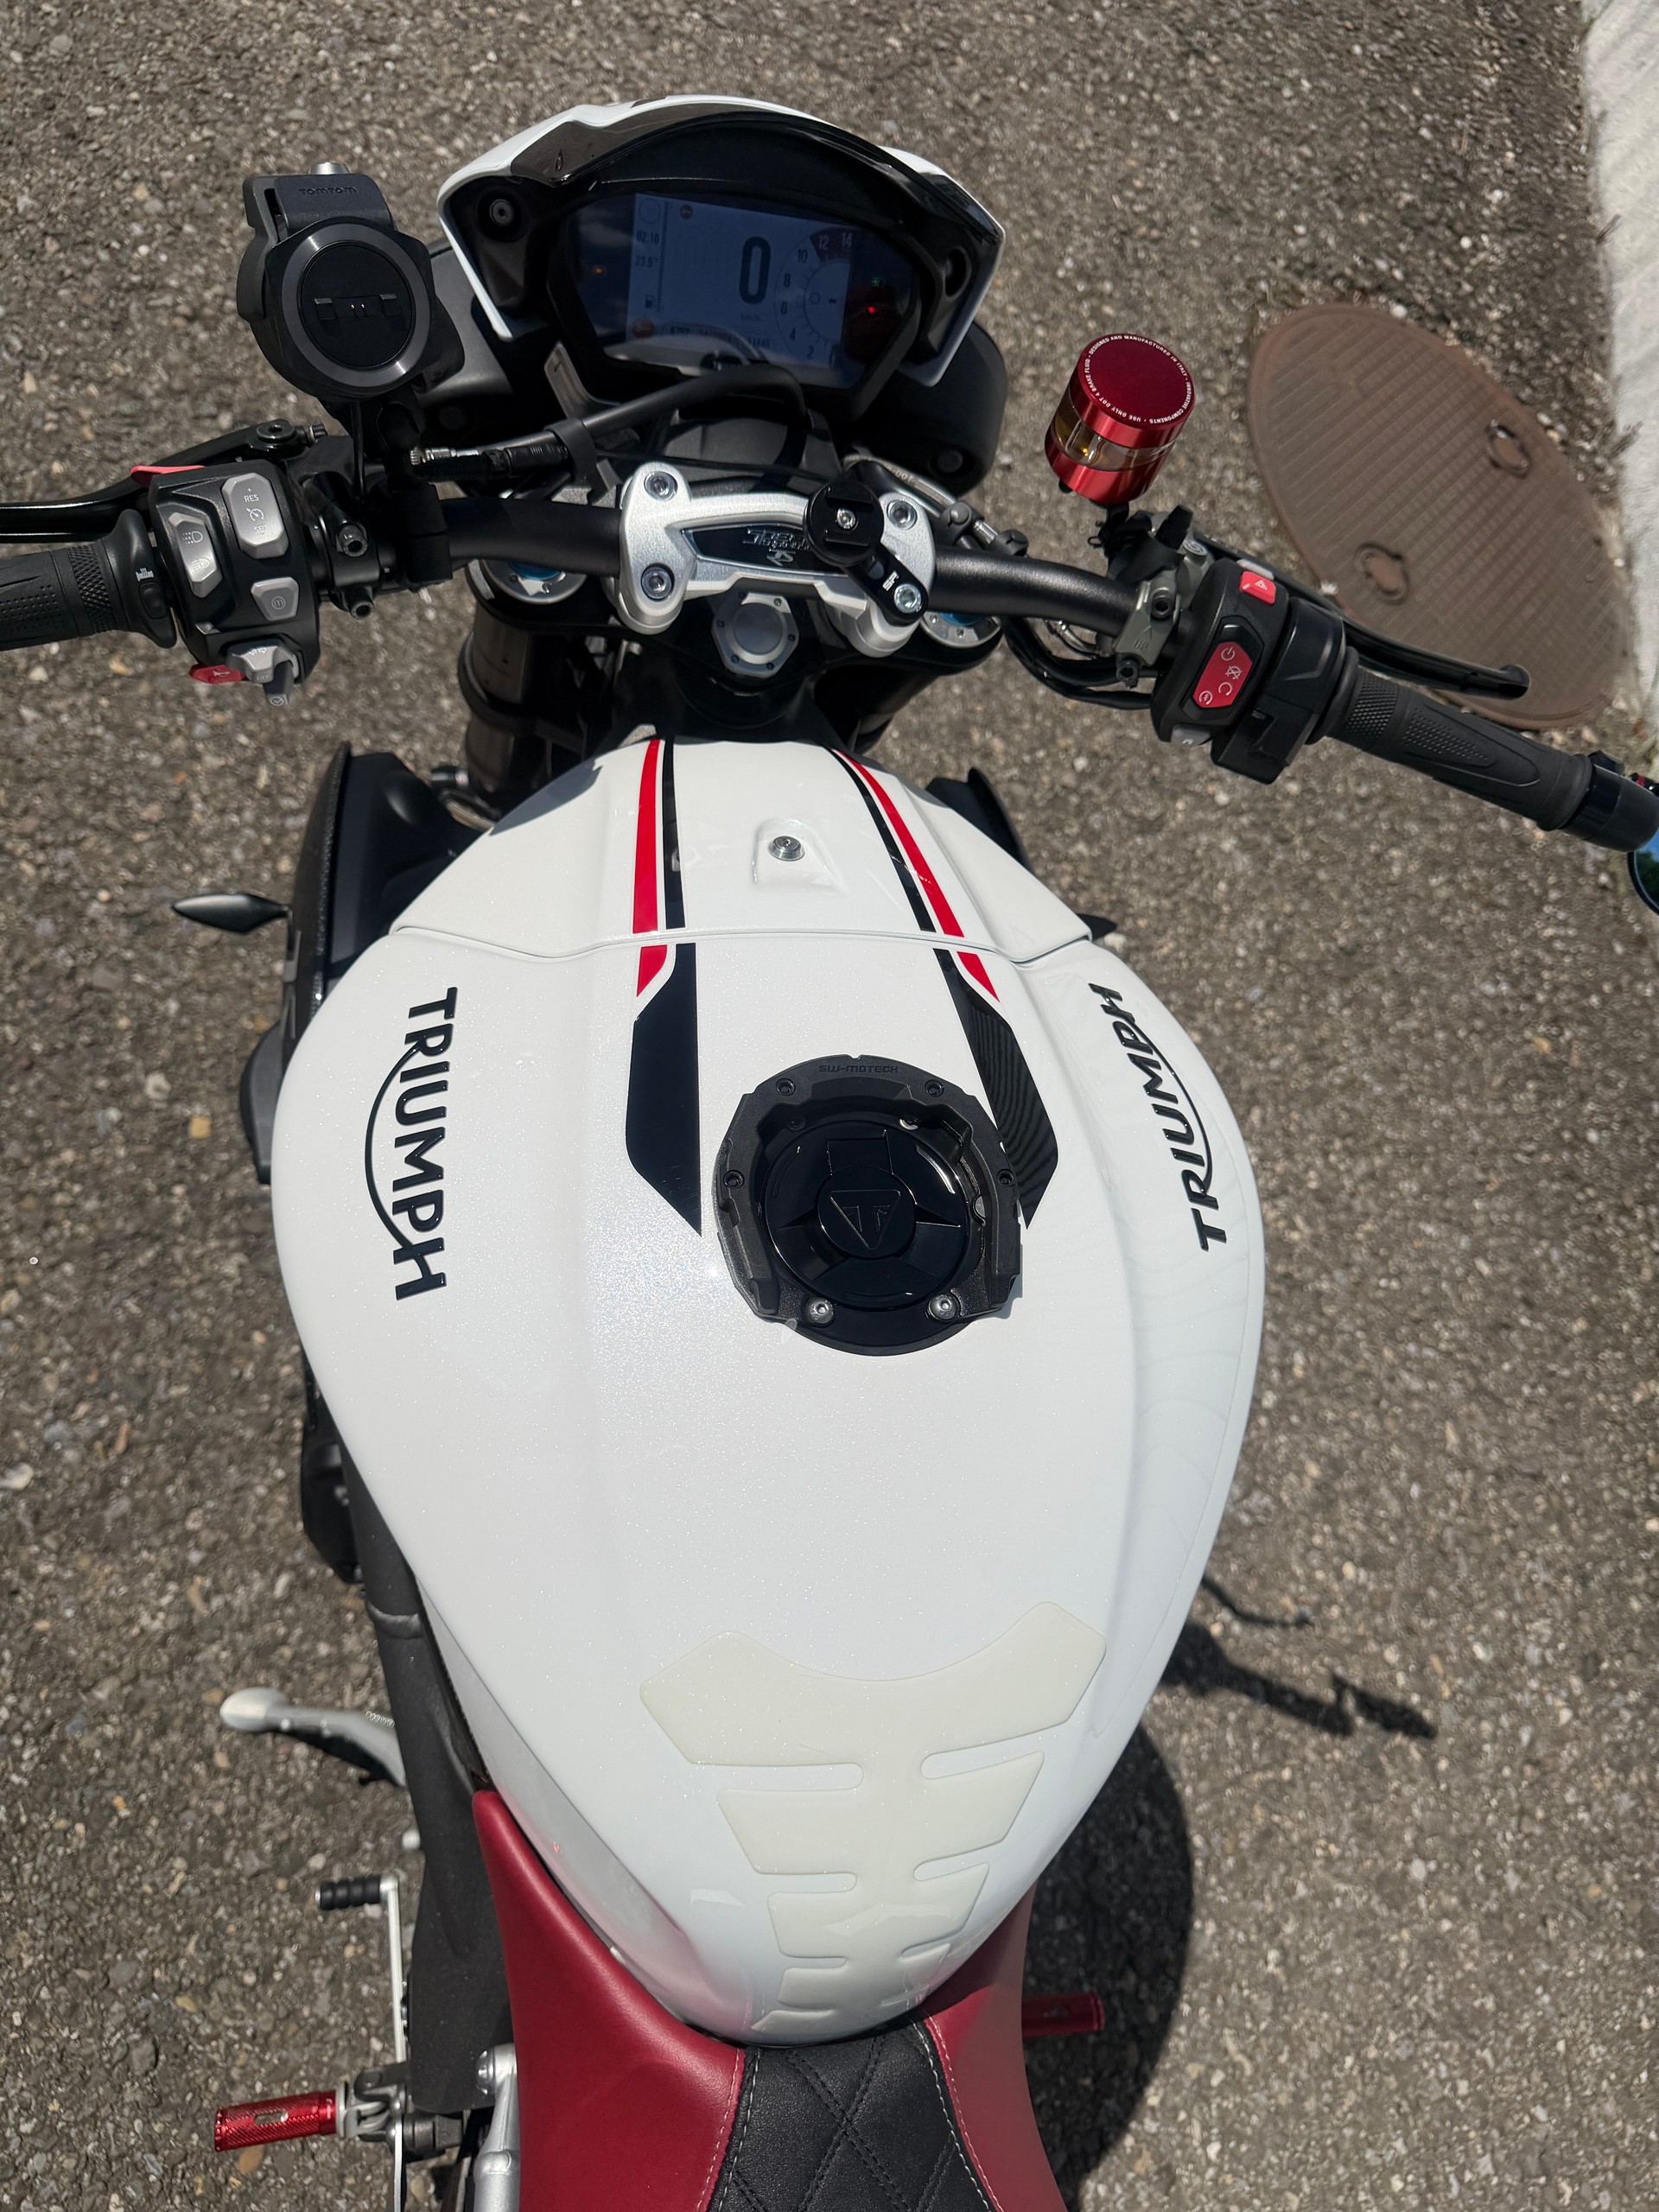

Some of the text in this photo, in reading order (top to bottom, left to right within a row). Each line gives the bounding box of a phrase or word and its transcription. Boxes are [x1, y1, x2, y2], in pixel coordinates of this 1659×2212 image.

[818, 235, 830, 250] 12
[842, 232, 853, 247] 14
[798, 249, 808, 264] 10
[739, 236, 771, 305] 0
[784, 273, 791, 288] 8
[780, 302, 787, 315] 6
[790, 327, 796, 341] 4
[807, 346, 814, 359] 2
[1123, 335, 1171, 356] MANUFACTURED
[1176, 362, 1188, 377] ITALY
[1098, 397, 1111, 408] DOT
[1111, 406, 1127, 417] ONLY
[1149, 408, 1184, 424] COMPONENTS
[244, 494, 260, 503] RES
[818, 1064, 899, 1074] SW-MOTECH
[1088, 983, 1227, 1251] TRIUMPH
[365, 987, 458, 1300] TRIUMPH
